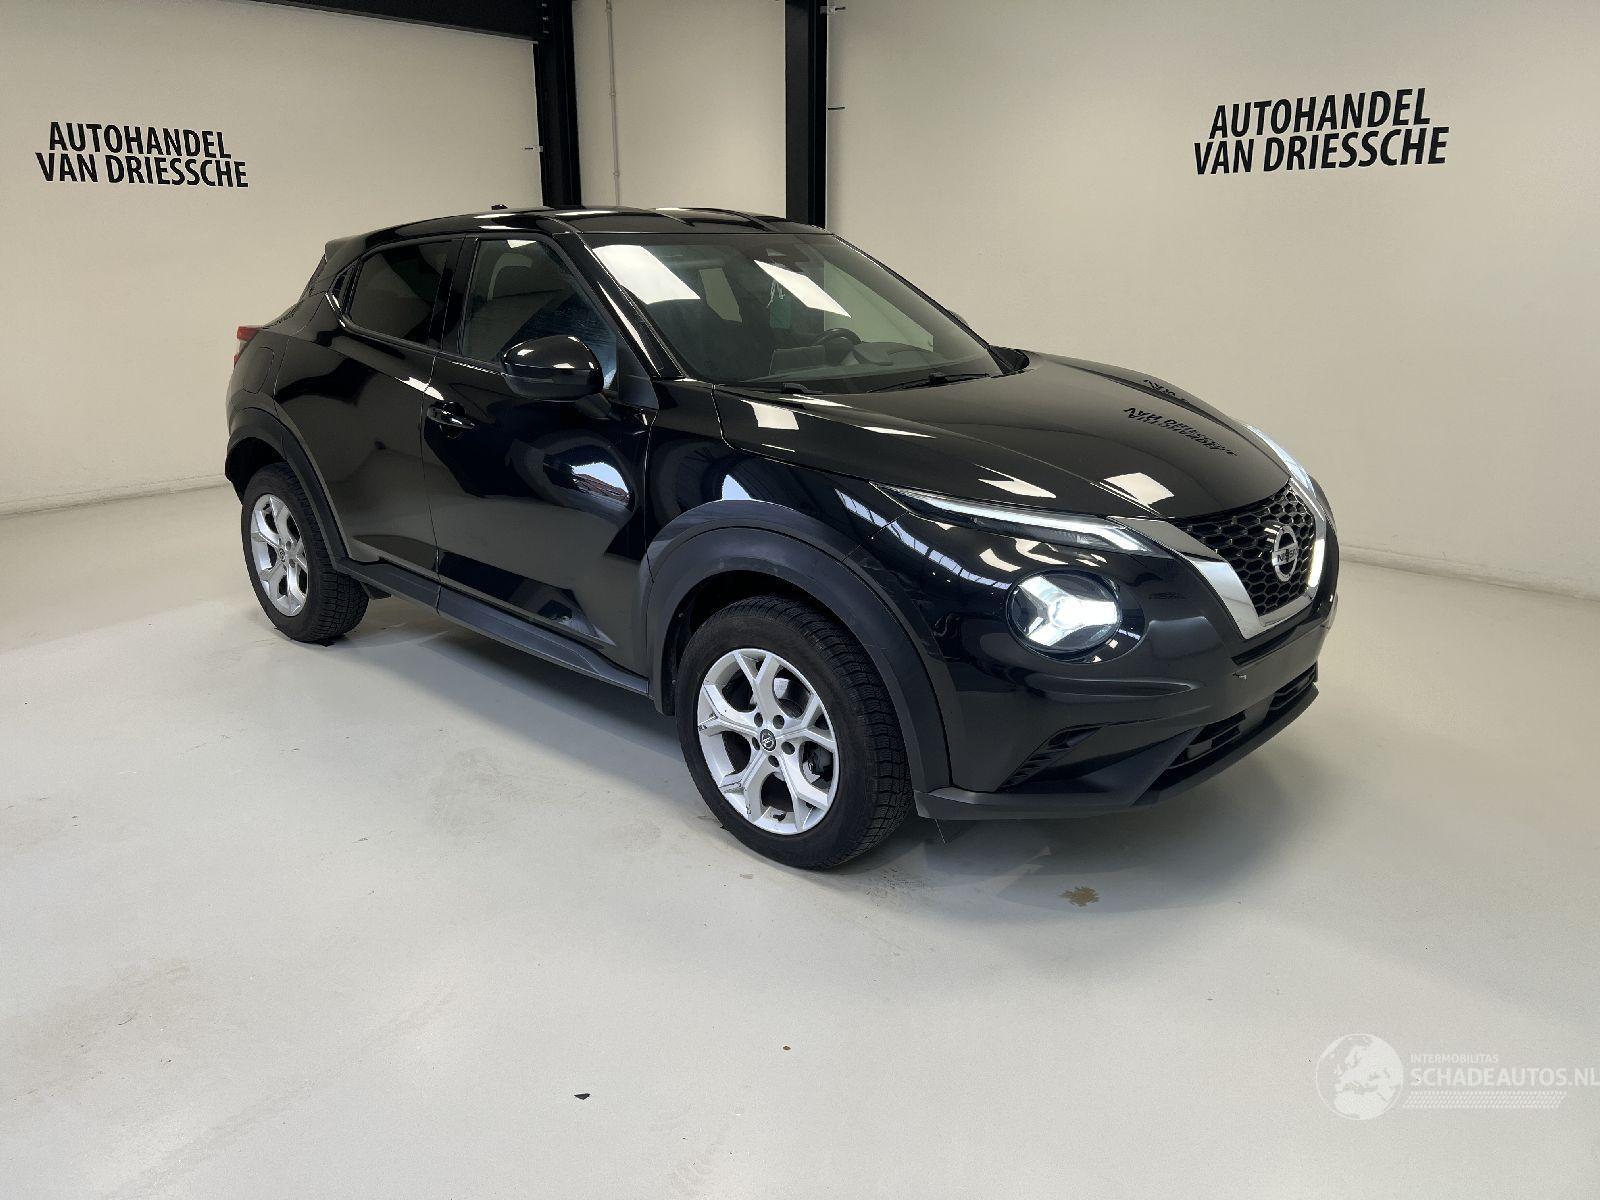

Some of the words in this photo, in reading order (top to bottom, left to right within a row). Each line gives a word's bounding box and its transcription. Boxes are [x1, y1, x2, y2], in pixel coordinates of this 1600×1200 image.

[1209, 88, 1430, 139] AUTOHANDEL
[49, 121, 232, 159] AUTOHANDEL
[1194, 139, 1254, 175] VAN
[1263, 127, 1449, 172] DRIESSCHE
[35, 152, 98, 182] VAN
[105, 155, 249, 187] DRIESSCHE
